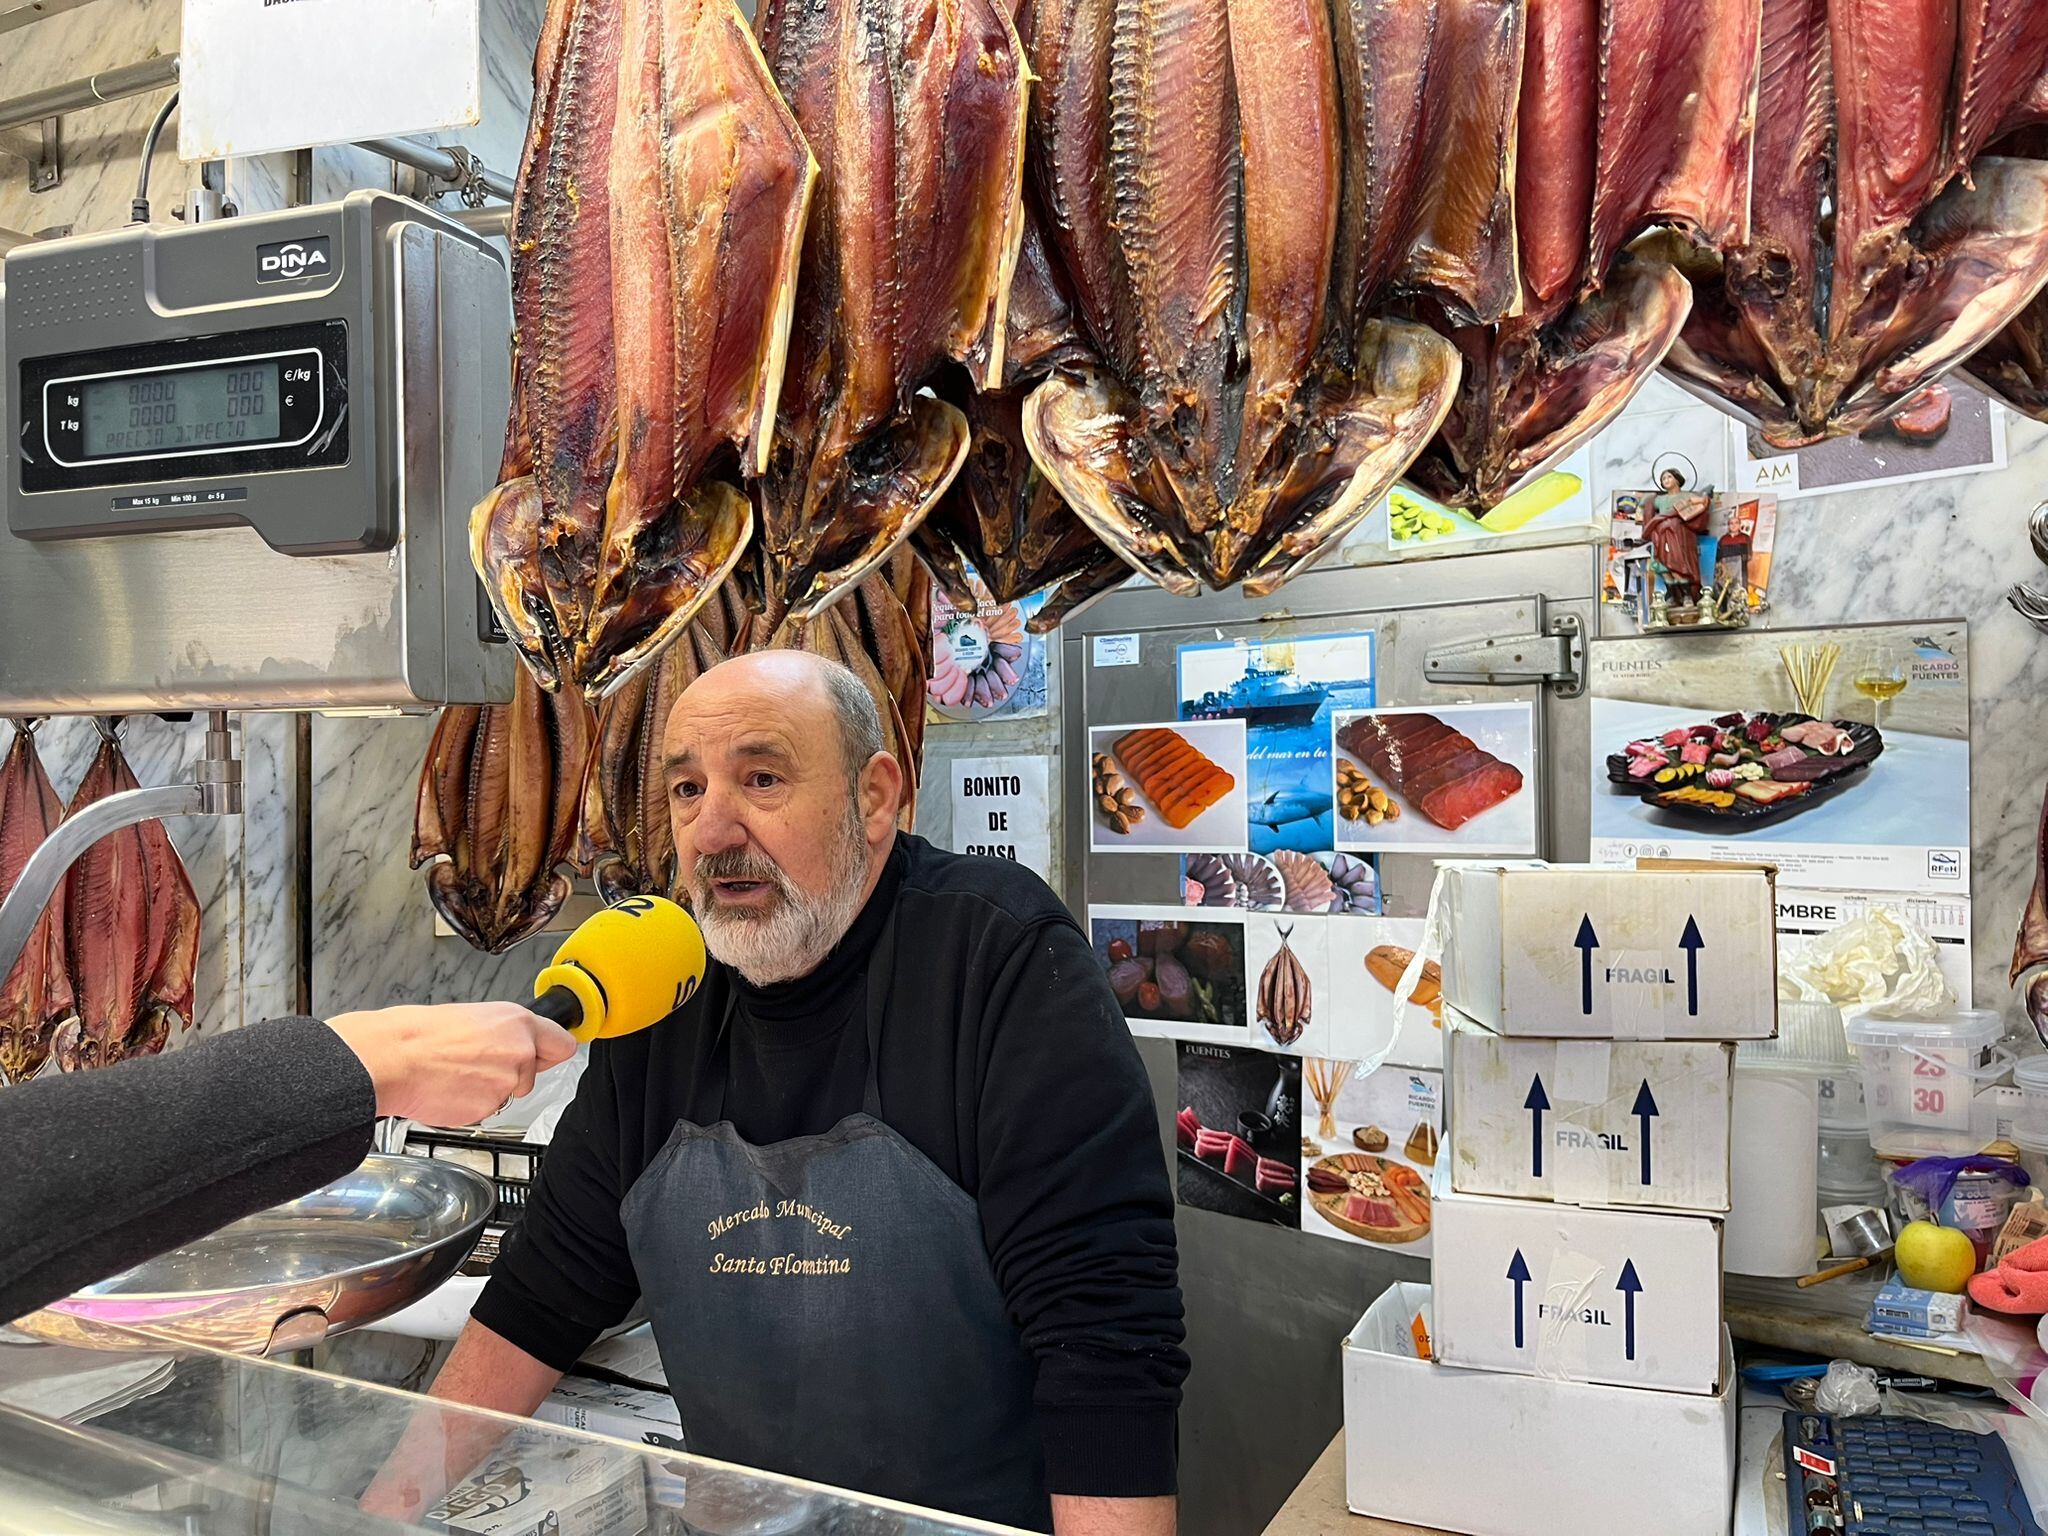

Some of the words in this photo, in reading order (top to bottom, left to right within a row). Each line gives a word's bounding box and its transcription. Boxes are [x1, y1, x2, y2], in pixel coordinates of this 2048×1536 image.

[262, 250, 327, 271] DINA
[284, 368, 311, 382] €/kg
[67, 395, 79, 408] kg
[284, 395, 295, 407] €
[67, 420, 79, 432] kg
[1602, 659, 1663, 672] FUENTES
[1912, 672, 1960, 680] FUENTES
[1266, 750, 1293, 760] mar
[1295, 750, 1312, 759] en
[964, 776, 1021, 797] BONITO
[989, 812, 1008, 832] DE
[1605, 968, 1675, 983] FRAGIL
[1185, 1044, 1231, 1059] FUENTES
[1914, 1088, 1945, 1114] 30
[1556, 1131, 1629, 1151] FRAGIL
[709, 1253, 767, 1273] Santa
[1539, 1304, 1612, 1326] FRAGIL
[425, 1484, 507, 1520] DIEGO
